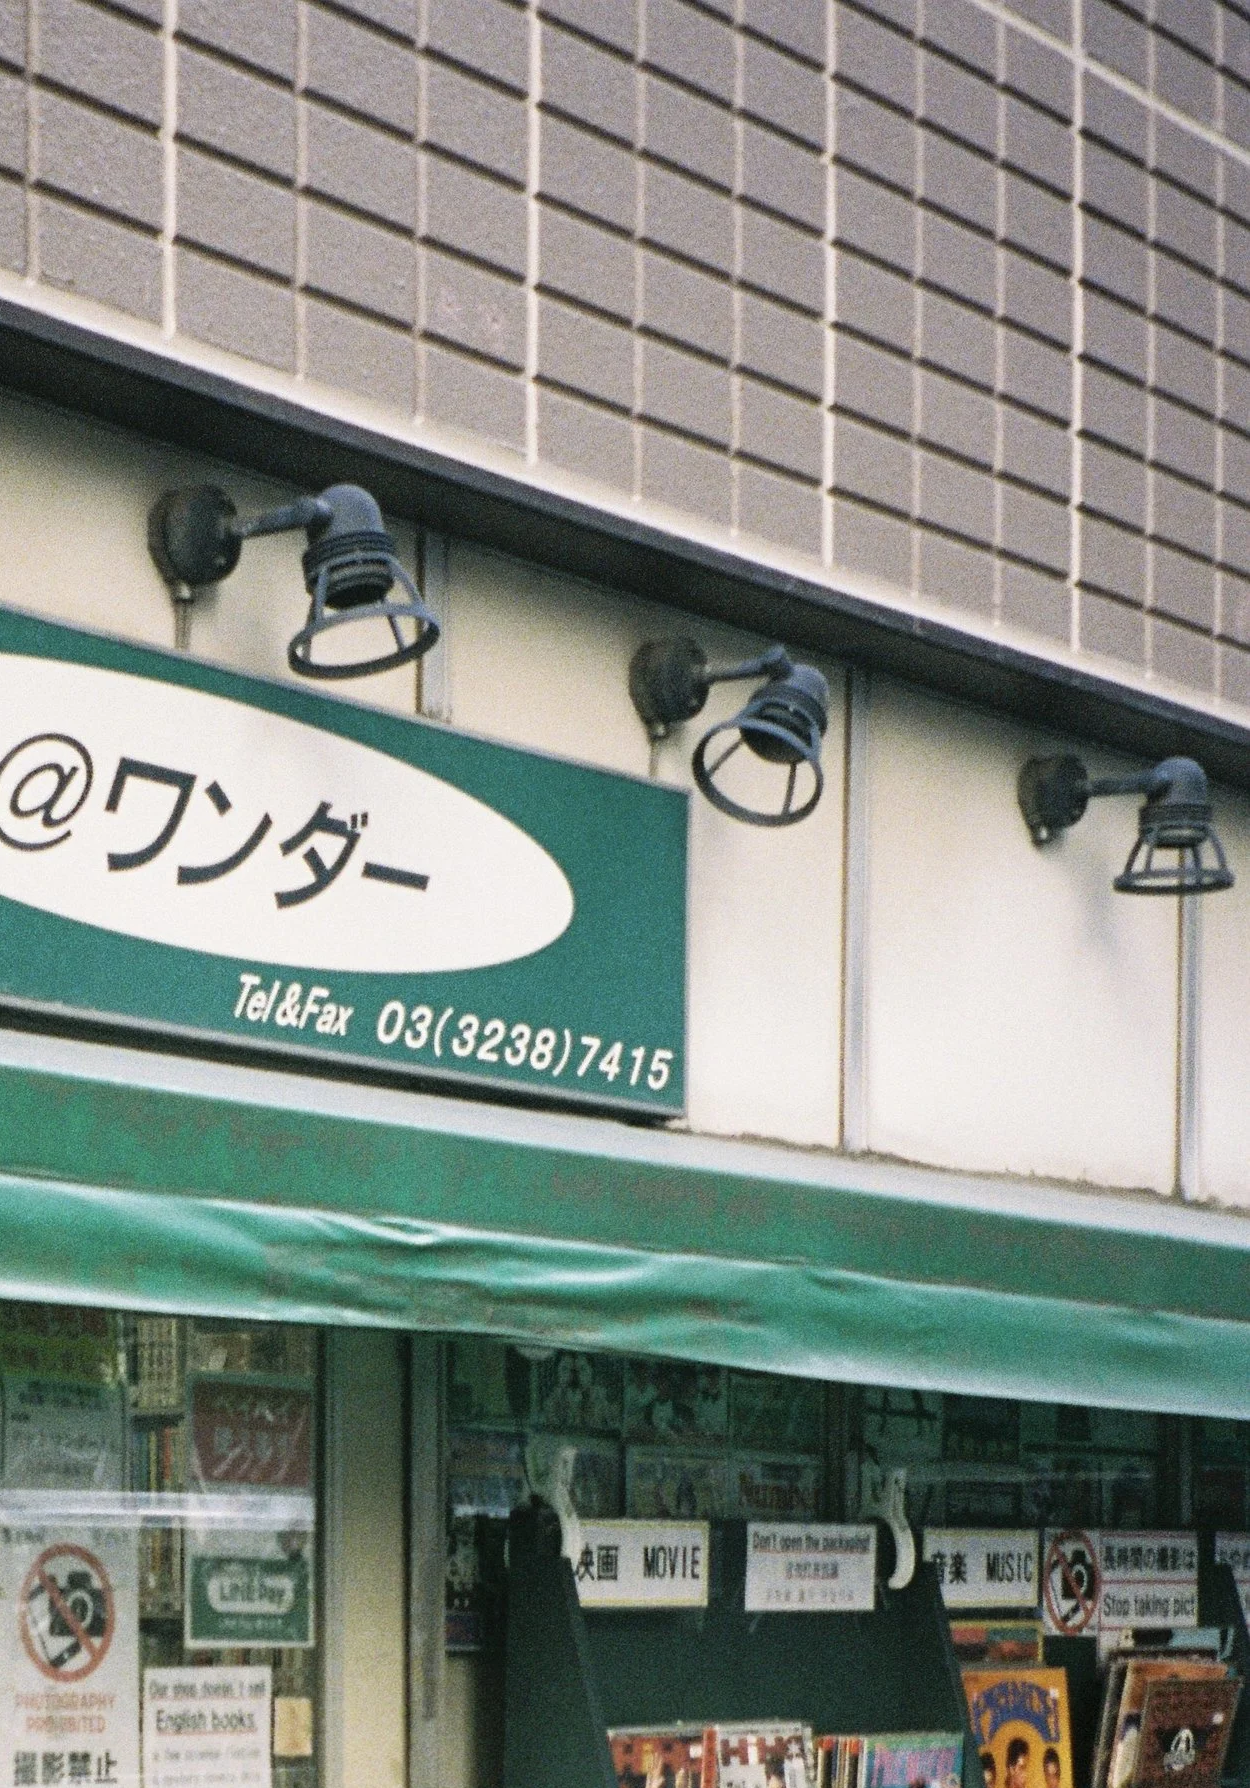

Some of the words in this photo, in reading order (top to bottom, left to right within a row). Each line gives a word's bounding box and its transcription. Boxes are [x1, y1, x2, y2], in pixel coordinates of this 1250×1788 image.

[232, 974, 354, 1037] Tel&Fax
[376, 1000, 674, 1091] 03(3238)7415
[643, 1545, 701, 1580] MOVIE
[986, 1551, 1033, 1584] MUSIC
[156, 1709, 207, 1734] English
[13, 1750, 118, 1787] 撮影禁止
